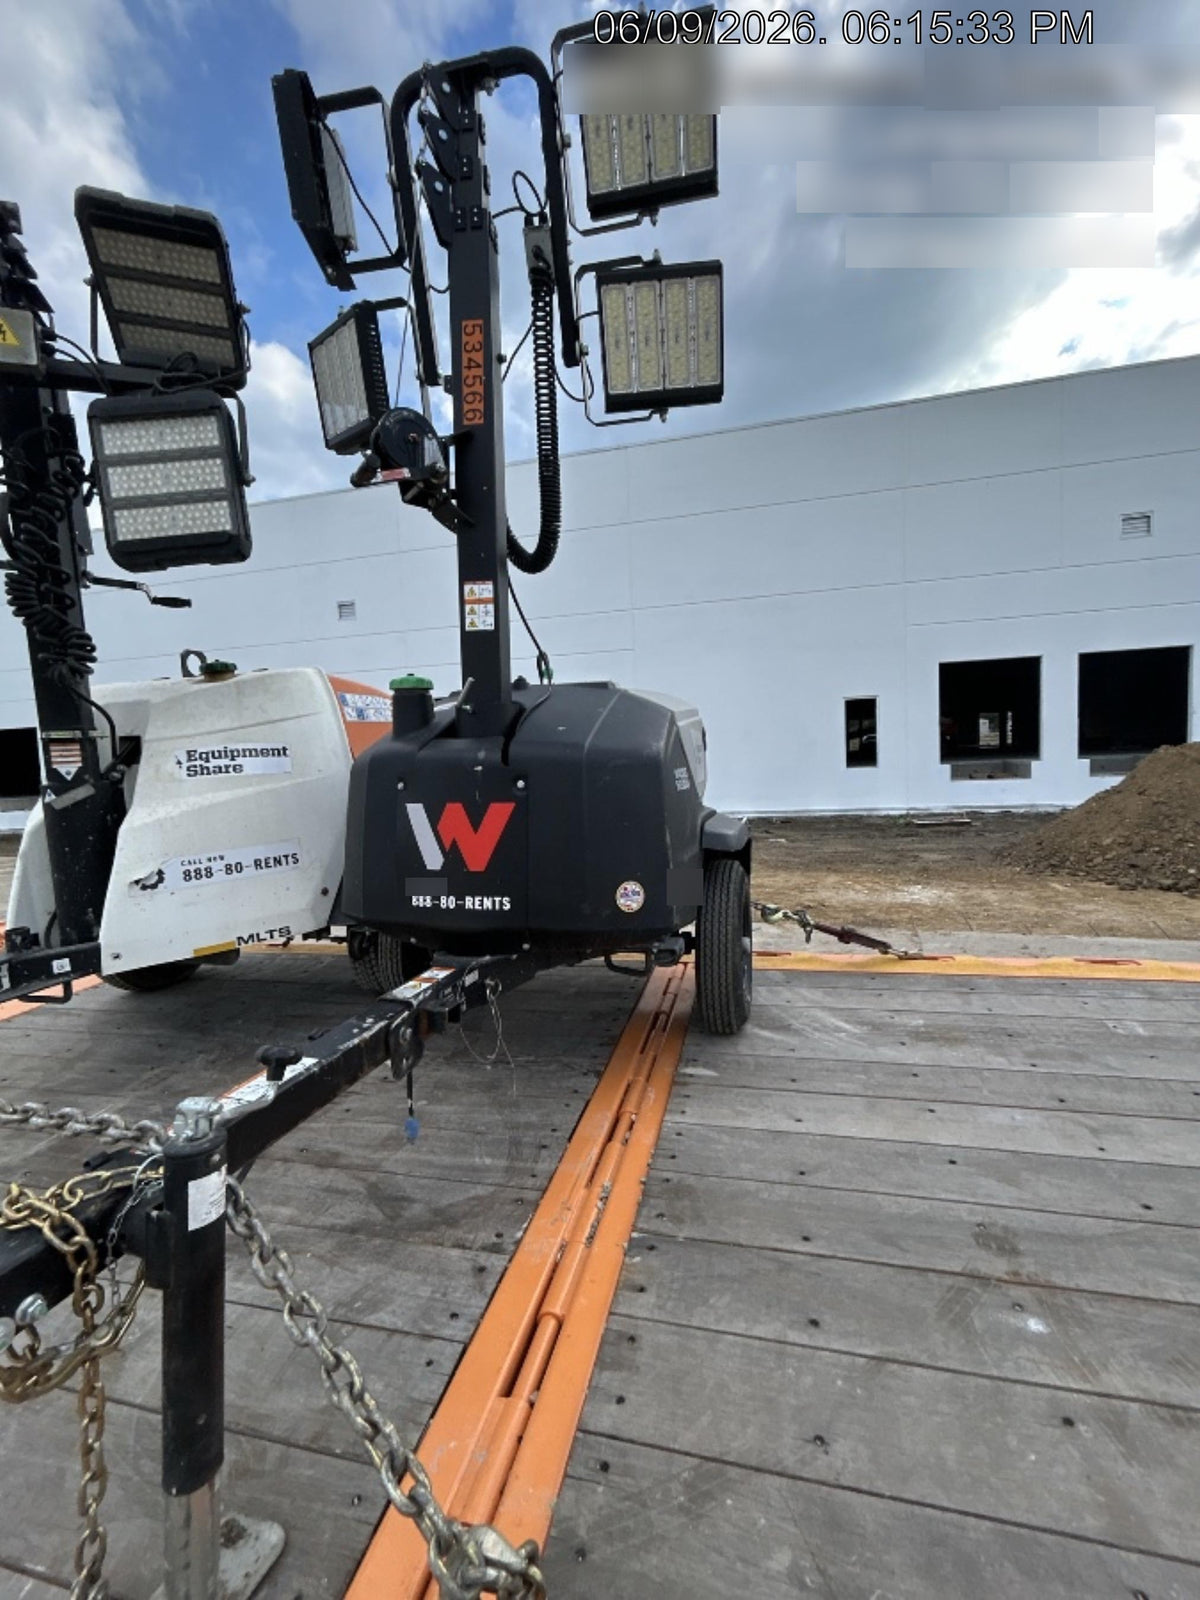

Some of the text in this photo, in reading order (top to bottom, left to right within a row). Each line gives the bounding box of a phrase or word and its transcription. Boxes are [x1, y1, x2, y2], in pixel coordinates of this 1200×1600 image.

[463, 323, 483, 422] 534566
[186, 746, 289, 763] Equipment
[186, 763, 244, 778] Share
[182, 852, 300, 882] 888-80-RENTS
